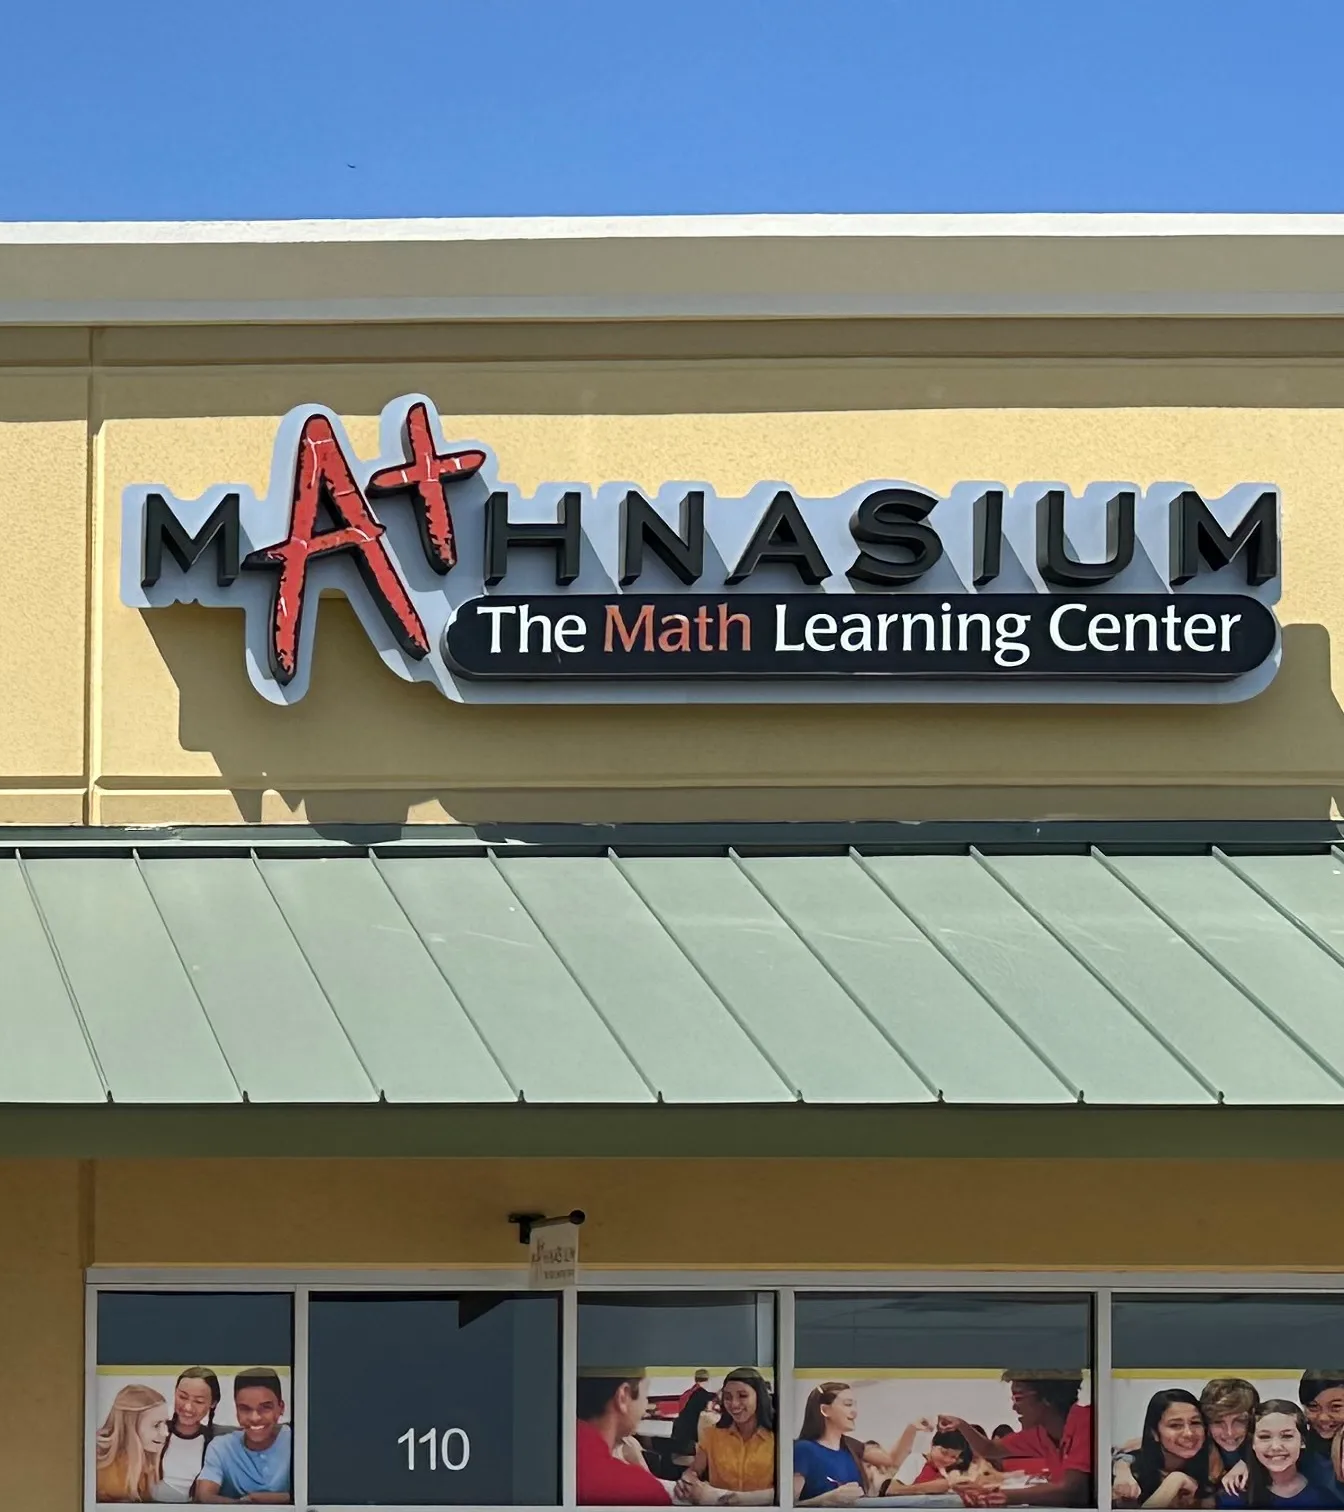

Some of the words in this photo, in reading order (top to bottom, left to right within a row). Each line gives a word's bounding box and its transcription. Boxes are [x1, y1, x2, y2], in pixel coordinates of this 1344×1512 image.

[476, 604, 587, 654] The
[604, 602, 751, 653] Math
[774, 602, 1032, 667] Learning
[1049, 602, 1242, 653] Center
[397, 1427, 470, 1470] 110
